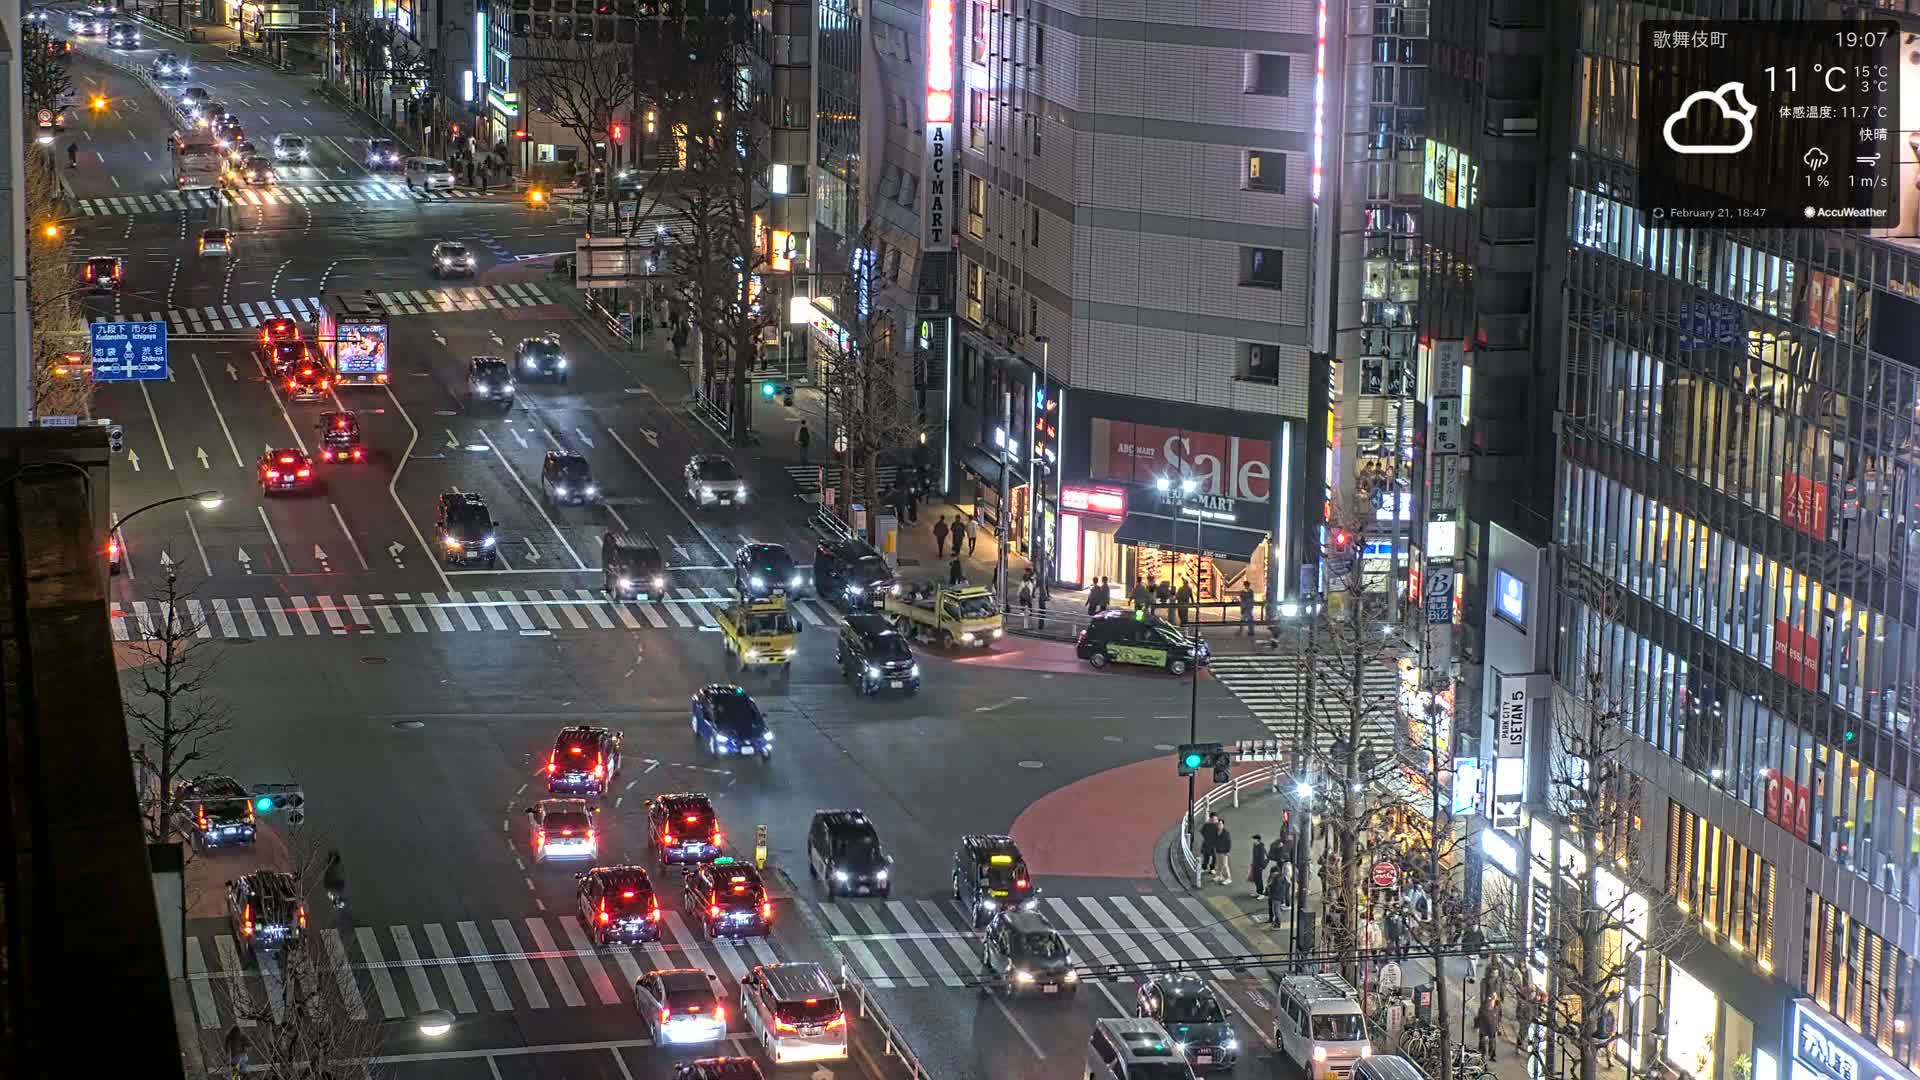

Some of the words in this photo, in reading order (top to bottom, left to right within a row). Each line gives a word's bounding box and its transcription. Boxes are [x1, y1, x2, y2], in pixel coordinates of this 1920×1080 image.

[97, 324, 126, 334] 九段下
[1163, 435, 1270, 502] Sale
[1787, 481, 1823, 530] 会計
[1436, 513, 1448, 522] 7F
[1512, 690, 1525, 701] 5
[1503, 701, 1511, 718] CITY
[1502, 719, 1510, 739] PARK
[1510, 704, 1524, 745] ISETAN
